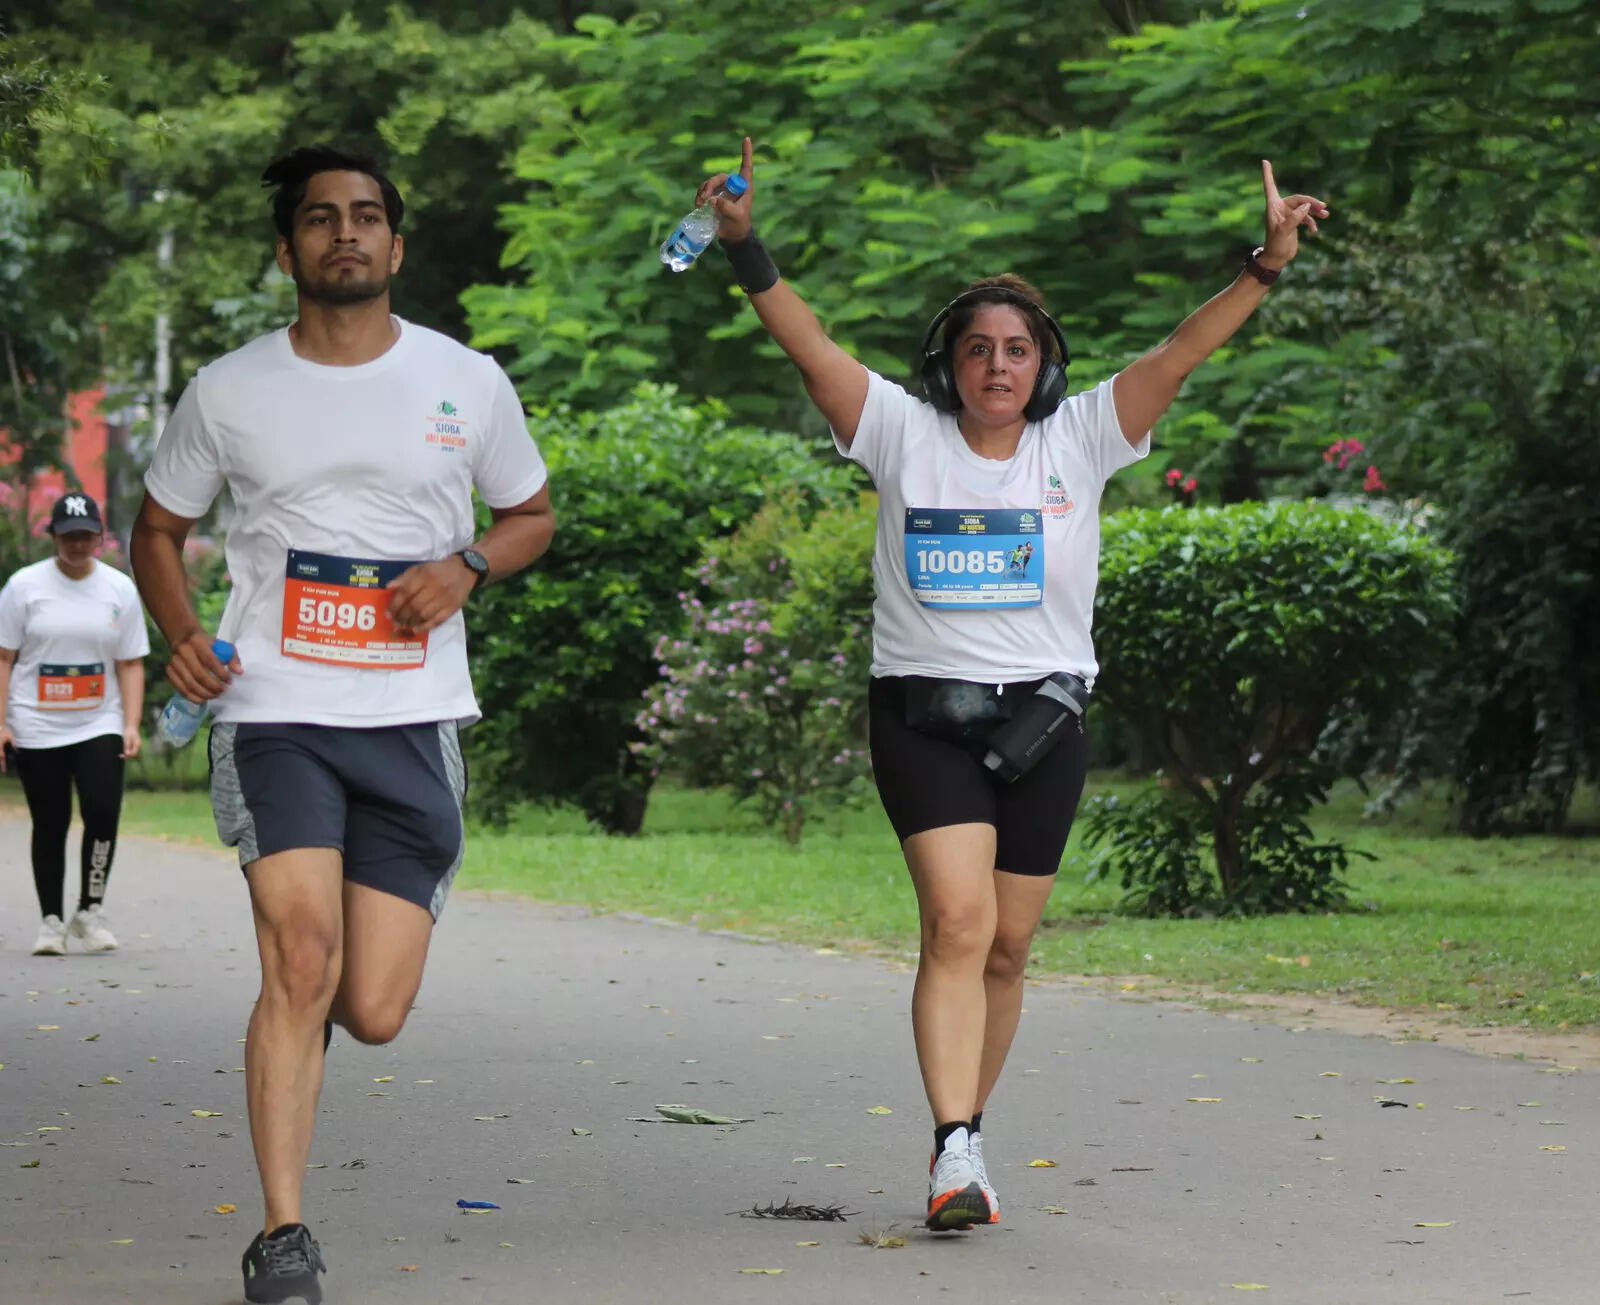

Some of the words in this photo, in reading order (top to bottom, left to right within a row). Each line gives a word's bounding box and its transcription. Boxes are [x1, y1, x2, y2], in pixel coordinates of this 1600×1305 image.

[65, 496, 88, 516] NY
[917, 550, 1005, 574] 10085
[298, 597, 376, 630] 5096
[88, 838, 110, 898] EDGE
